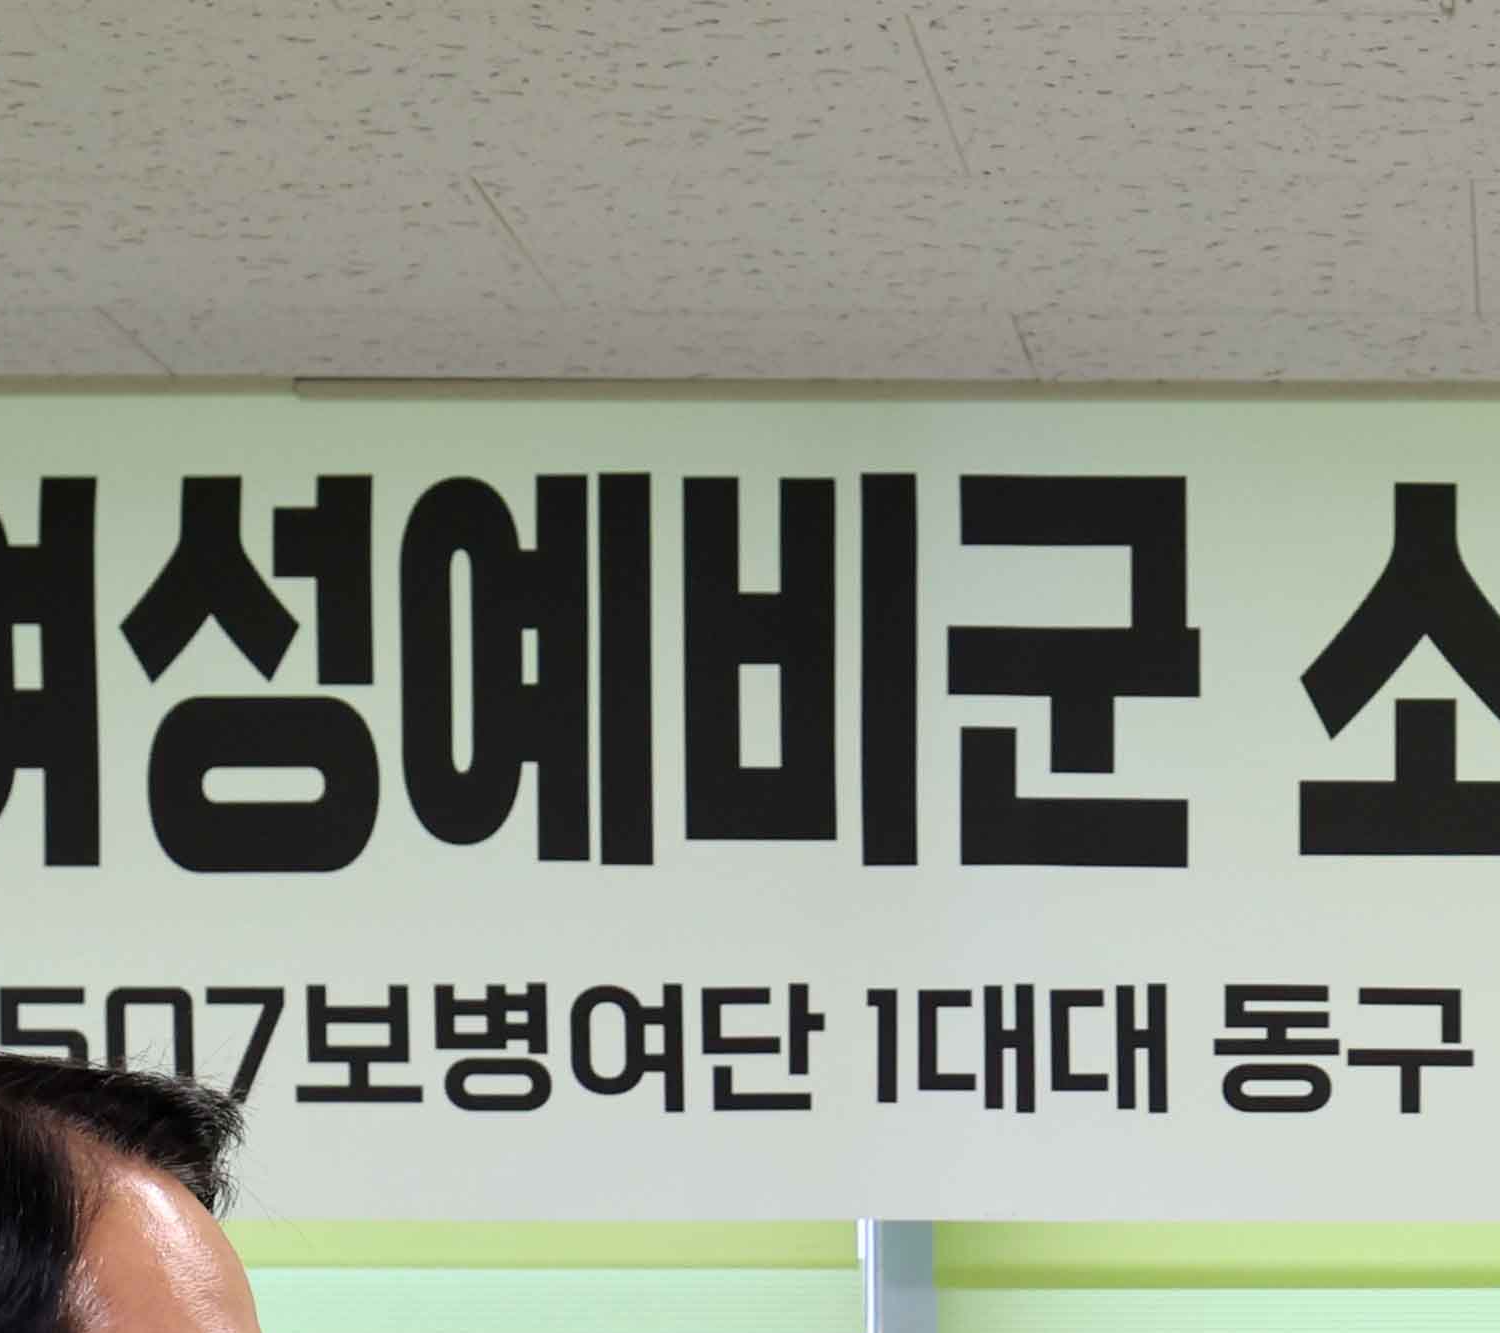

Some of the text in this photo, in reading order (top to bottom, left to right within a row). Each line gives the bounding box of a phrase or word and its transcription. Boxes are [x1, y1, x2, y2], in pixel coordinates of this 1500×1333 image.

[0, 984, 826, 1114] 507보병여단
[868, 984, 1169, 1115] 1대대
[1214, 985, 1475, 1115] 동구
